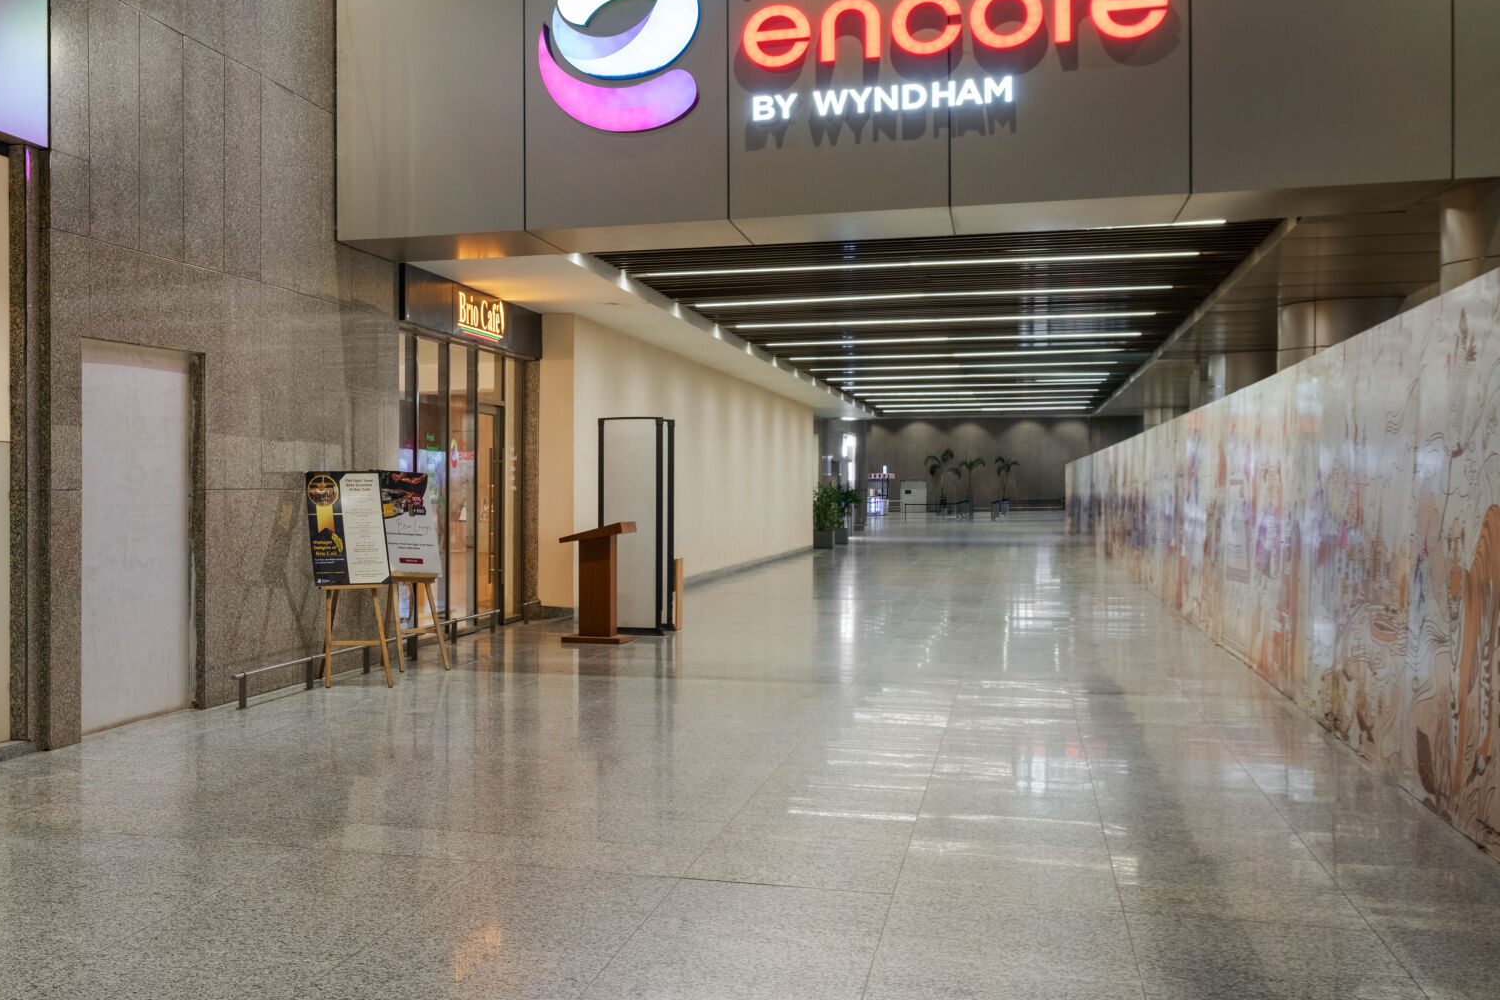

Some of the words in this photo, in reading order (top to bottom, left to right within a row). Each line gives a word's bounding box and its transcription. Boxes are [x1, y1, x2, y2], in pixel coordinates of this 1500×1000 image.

[752, 93, 798, 121] BY
[812, 76, 1013, 116] WYNDHAM
[458, 291, 479, 327] Brio
